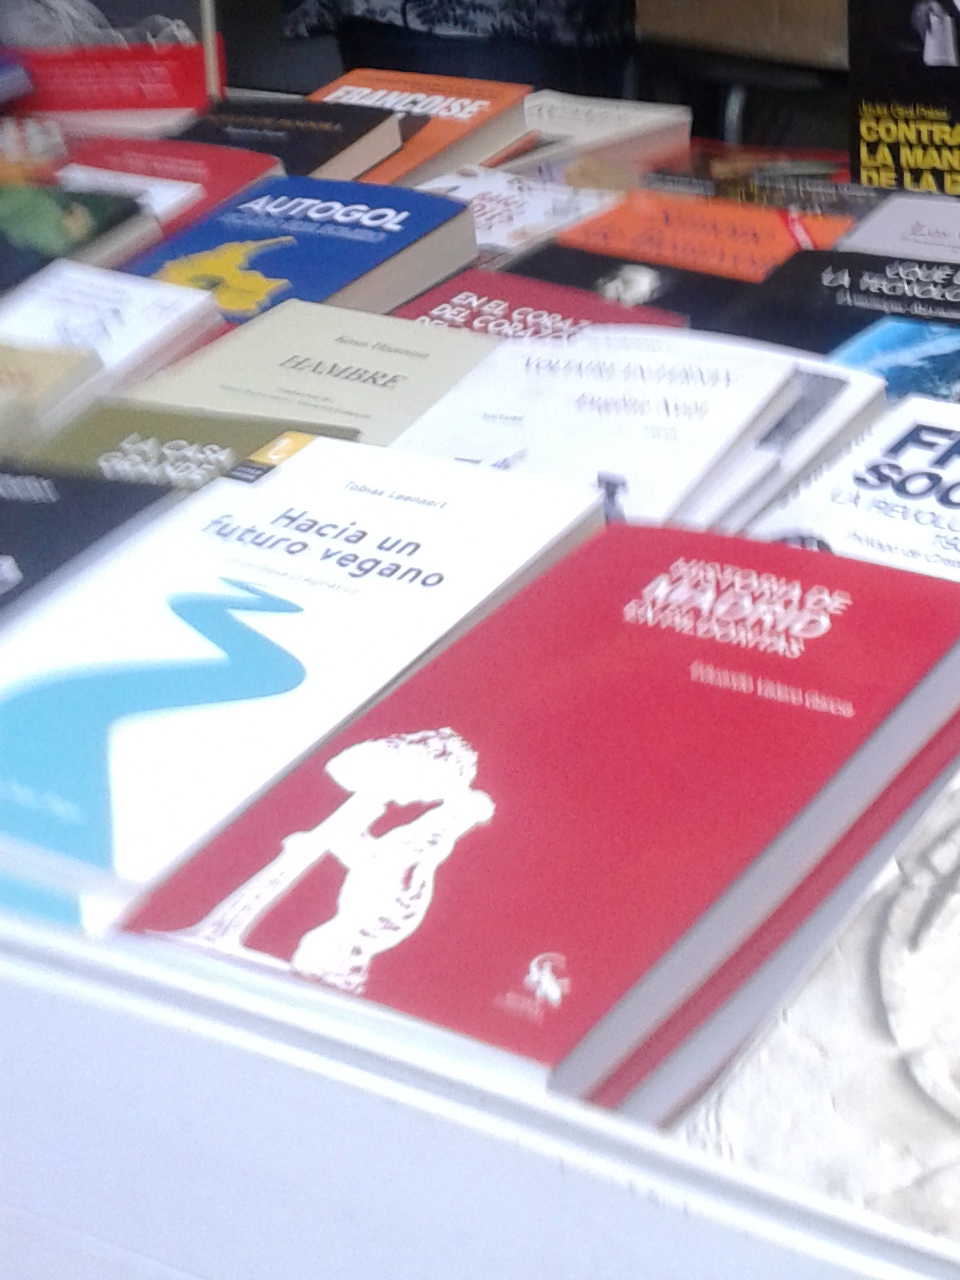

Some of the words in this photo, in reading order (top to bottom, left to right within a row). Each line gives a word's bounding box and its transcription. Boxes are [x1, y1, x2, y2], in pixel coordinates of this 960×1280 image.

[860, 140, 894, 168] LA
[860, 167, 896, 188] DE
[903, 170, 938, 194] LA
[236, 194, 411, 232] AUTOGOL
[428, 303, 472, 327] DEL
[449, 290, 487, 309] EN
[480, 298, 509, 317] EL
[277, 354, 410, 391] HAMBRE
[829, 487, 861, 510] LA
[269, 507, 369, 545] Hacia
[376, 535, 422, 557] un
[201, 513, 310, 556] futuro
[319, 546, 445, 589] vegano
[641, 572, 831, 639] MADRID
[803, 584, 854, 617] DE
